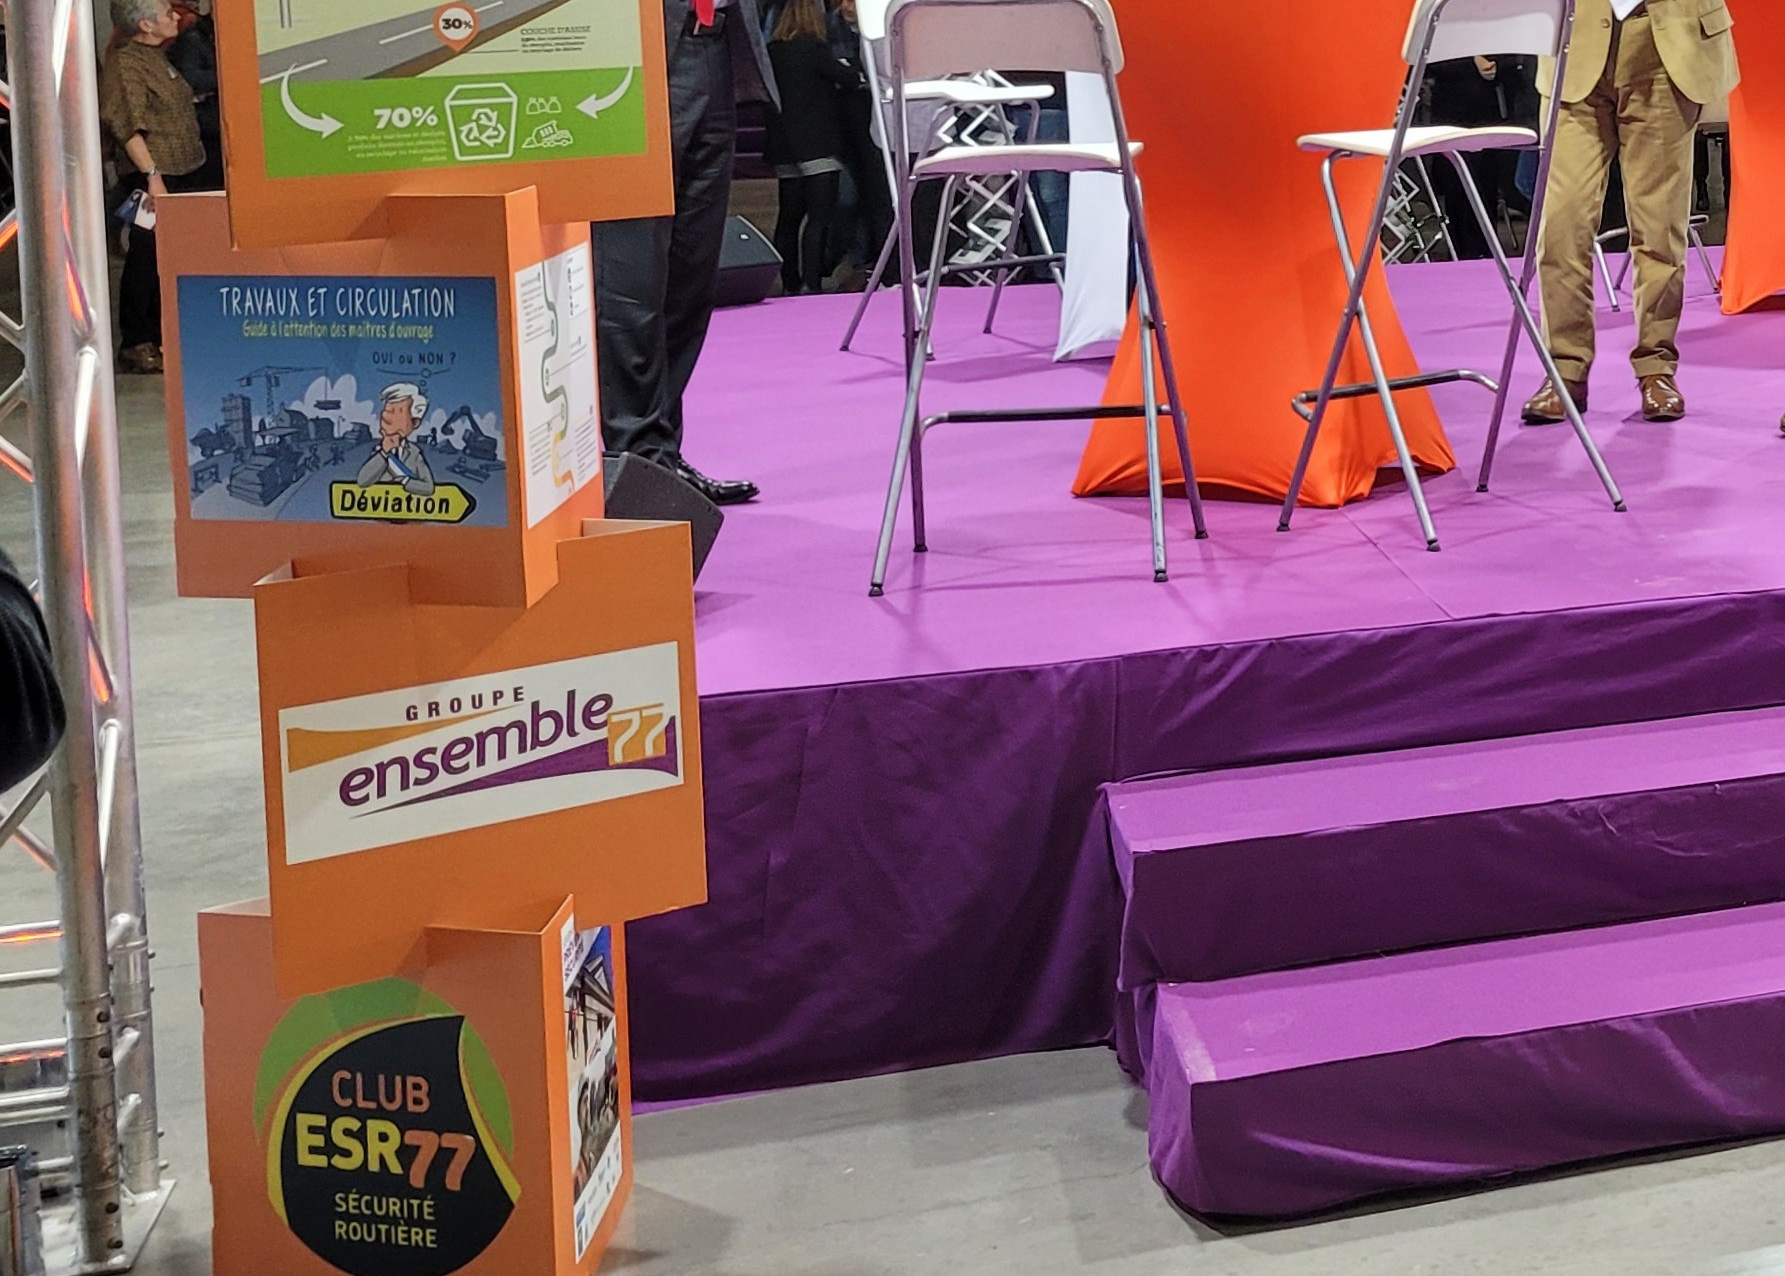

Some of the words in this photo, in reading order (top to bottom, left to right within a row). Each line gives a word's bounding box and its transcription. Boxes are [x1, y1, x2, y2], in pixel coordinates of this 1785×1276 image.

[441, 18, 473, 30] 30%
[374, 105, 439, 129] 70%
[220, 286, 300, 317] TRAVAUX
[307, 286, 328, 317] ET
[336, 287, 455, 319] CIRCULATION
[243, 319, 268, 338] Guide
[330, 321, 346, 337] des
[372, 351, 393, 364] OUI
[399, 354, 413, 364] ou
[418, 352, 444, 365] NON
[449, 352, 457, 365] ?
[340, 487, 450, 515] Déviation
[405, 685, 526, 721] GROUPE
[339, 689, 613, 807] ensemble
[610, 708, 666, 762] 77
[331, 1069, 430, 1113] CLUB
[334, 1188, 436, 1221] SÉCURITÉ
[335, 1220, 438, 1249] ROUTIÈRE
